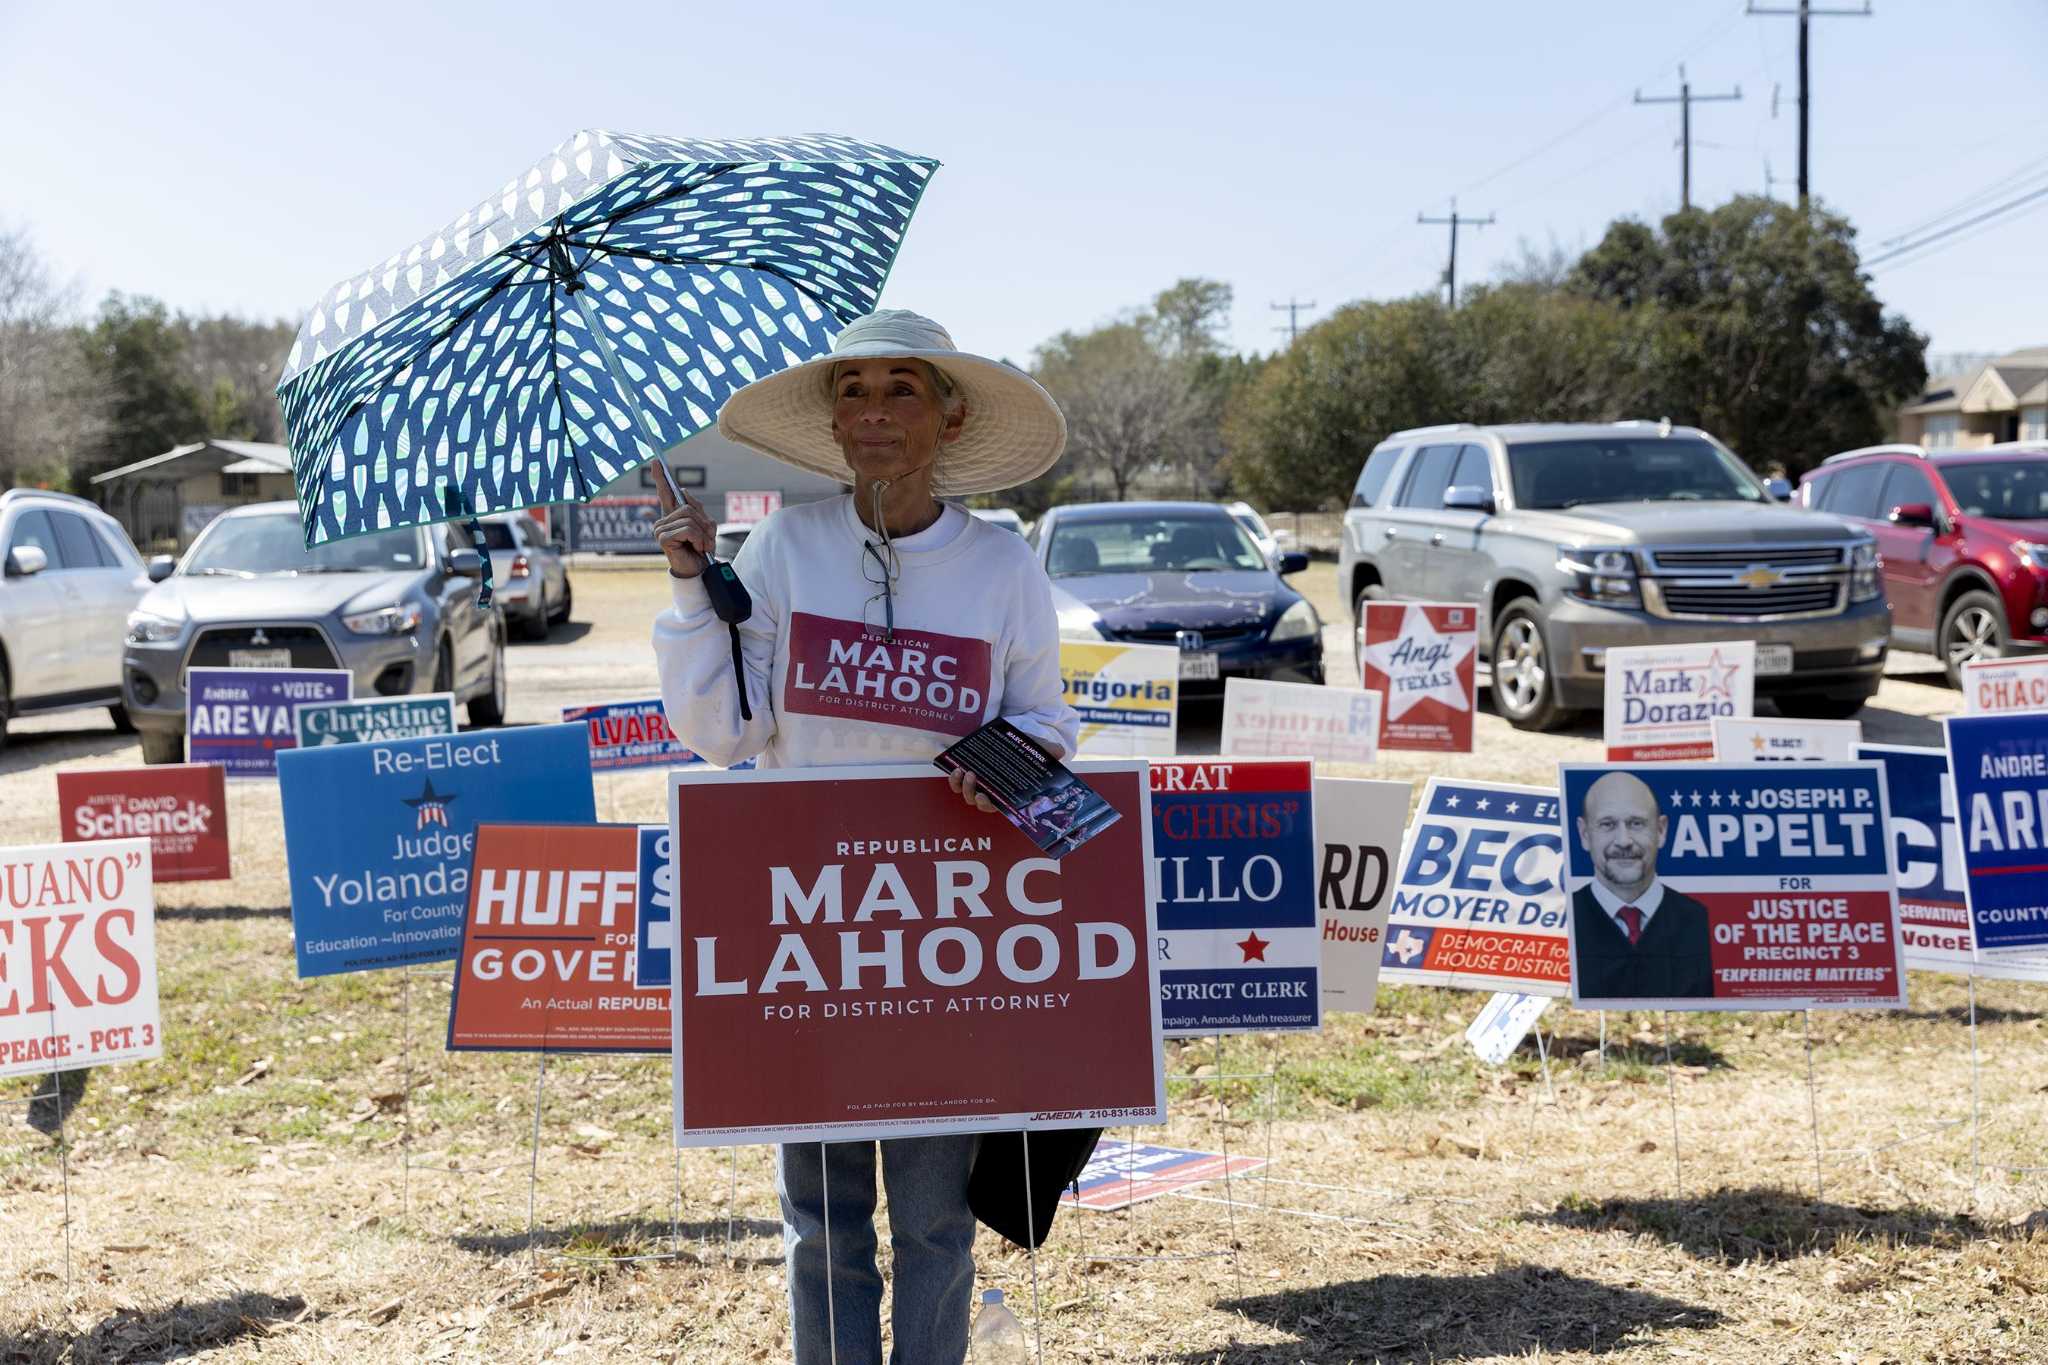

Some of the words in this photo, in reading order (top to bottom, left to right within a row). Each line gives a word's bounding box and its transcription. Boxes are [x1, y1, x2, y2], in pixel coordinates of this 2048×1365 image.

[578, 507, 627, 523] STEVE
[827, 639, 958, 681] MARC
[1389, 635, 1454, 671] Angi
[203, 687, 249, 700] ANDREA
[283, 682, 325, 699] VOTE
[794, 663, 981, 714] LAHOOD
[1395, 672, 1452, 692] TEXAS
[1624, 670, 1693, 695] Mark
[1979, 677, 2048, 710] CHAC
[192, 703, 299, 736] AREVA
[306, 703, 447, 734] Christine
[819, 695, 841, 706] FOR
[845, 698, 895, 713] DISTRICT
[900, 706, 955, 721] ATTORNEY
[1623, 695, 1735, 725] Dorazio
[373, 739, 502, 776] Re-Elect
[1980, 754, 2048, 780] ANDRE
[128, 795, 178, 812] DAVID
[1745, 788, 1844, 809] JOSEPH
[1854, 788, 1874, 809] P.
[74, 801, 210, 838] Schenck
[1969, 788, 2048, 852] AR
[393, 831, 473, 860] Judge
[836, 836, 993, 856] REPUBLICAN
[1670, 812, 1875, 858] APPELT
[1401, 823, 1566, 896] BEC
[0, 851, 141, 909] UANO”
[313, 862, 468, 908] Yolanda
[1319, 843, 1389, 911] RD
[1779, 877, 1813, 890] FOR
[475, 869, 637, 926] HUFF
[768, 857, 1063, 926] MARC
[384, 909, 409, 924] For
[410, 902, 464, 922] County
[1390, 891, 1510, 924] MOYER
[1747, 898, 1849, 920] JUSTICE
[305, 933, 378, 955] Education
[1323, 919, 1379, 943] House
[1441, 933, 1548, 956] DEMOCRAT
[1714, 923, 1745, 944] OF
[1752, 923, 1801, 943] THE
[1807, 922, 1886, 943] PEACE
[693, 920, 1137, 997] LAHOOD
[1434, 951, 1501, 971] HOUSE
[1743, 946, 1842, 960] PRECINCT
[1848, 946, 1860, 960] 3
[521, 997, 542, 1010] An
[546, 997, 593, 1010] Actual
[1161, 982, 1235, 1001] STRICT
[1241, 981, 1308, 998] CLERK
[764, 1004, 811, 1021] FOR
[823, 998, 934, 1019] DISTRICT
[945, 992, 1071, 1013] ATTORNEY
[1200, 1014, 1241, 1025] Amanda
[1242, 1014, 1269, 1024] Muth
[1269, 1014, 1312, 1024] treasurer
[0, 1034, 71, 1064] PEACE
[90, 1026, 137, 1053] PCT.
[142, 1024, 155, 1046] 3
[1030, 1111, 1083, 1121] JCMEDIA
[1089, 1107, 1157, 1119] 210-831-6838
